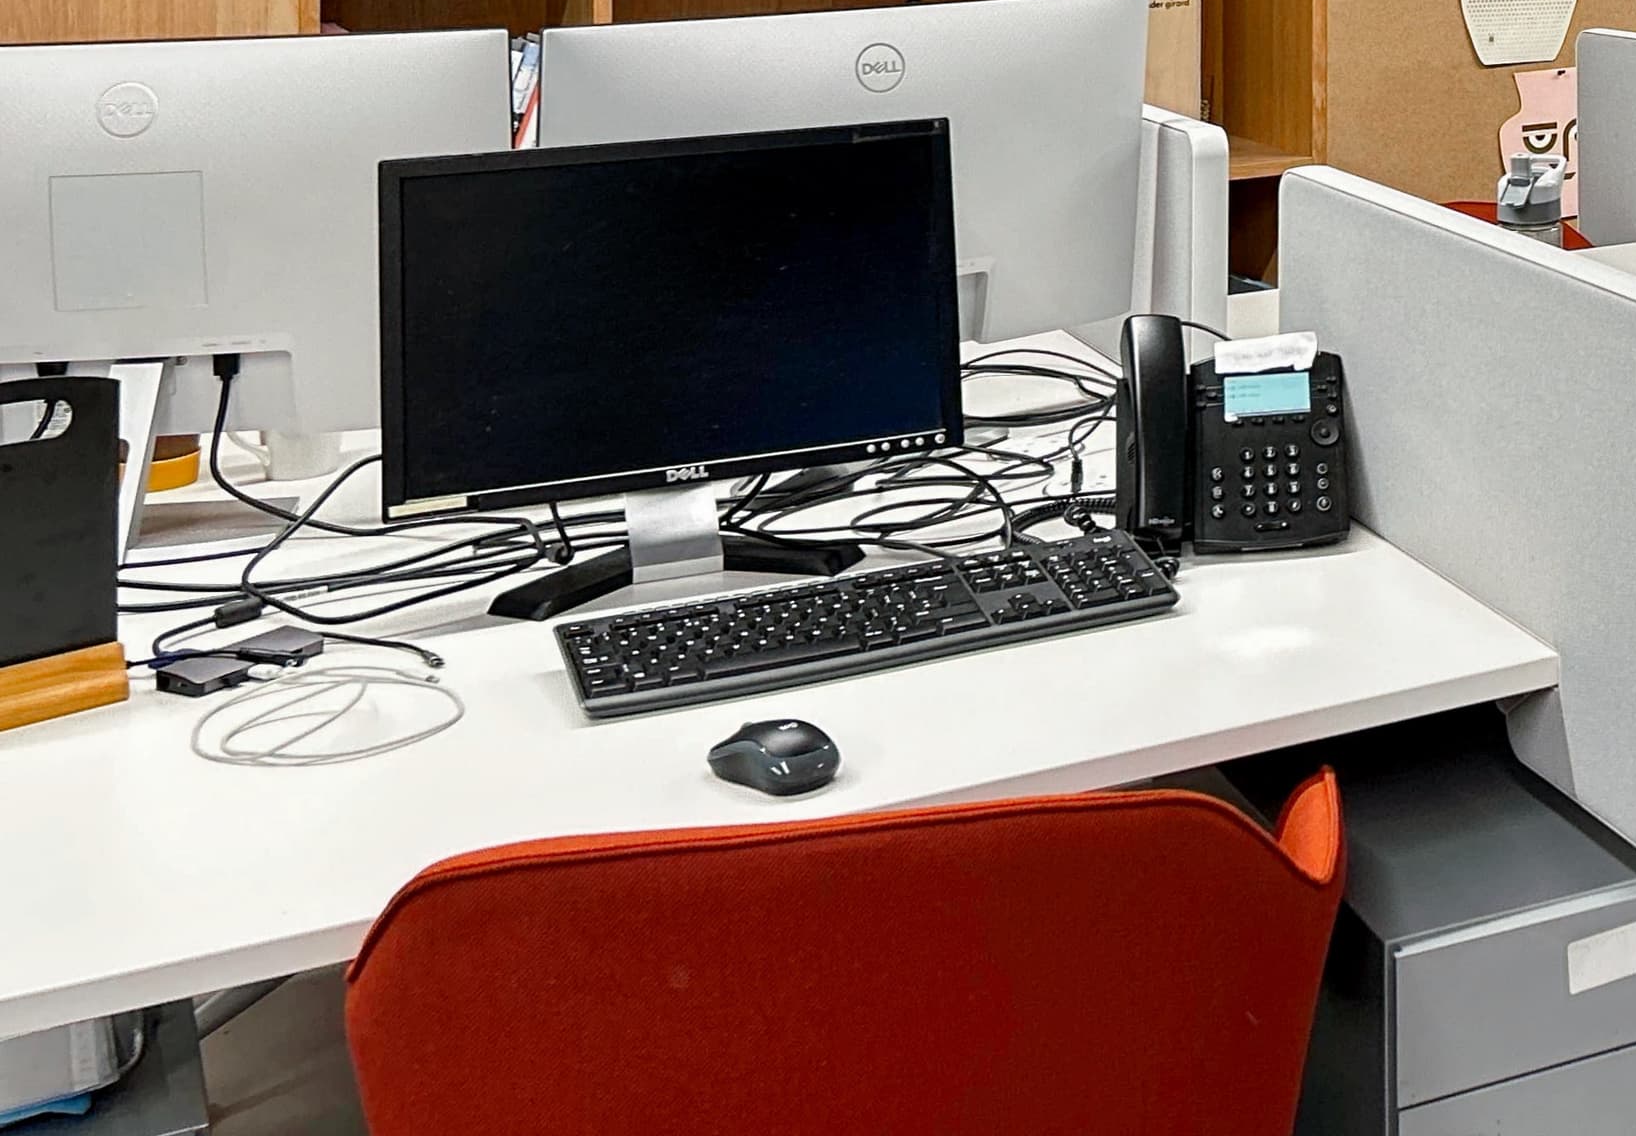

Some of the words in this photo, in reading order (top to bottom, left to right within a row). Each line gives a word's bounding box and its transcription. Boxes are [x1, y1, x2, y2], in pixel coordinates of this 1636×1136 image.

[862, 60, 902, 76] DELL
[103, 101, 155, 120] DELL
[666, 465, 709, 483] DELL
